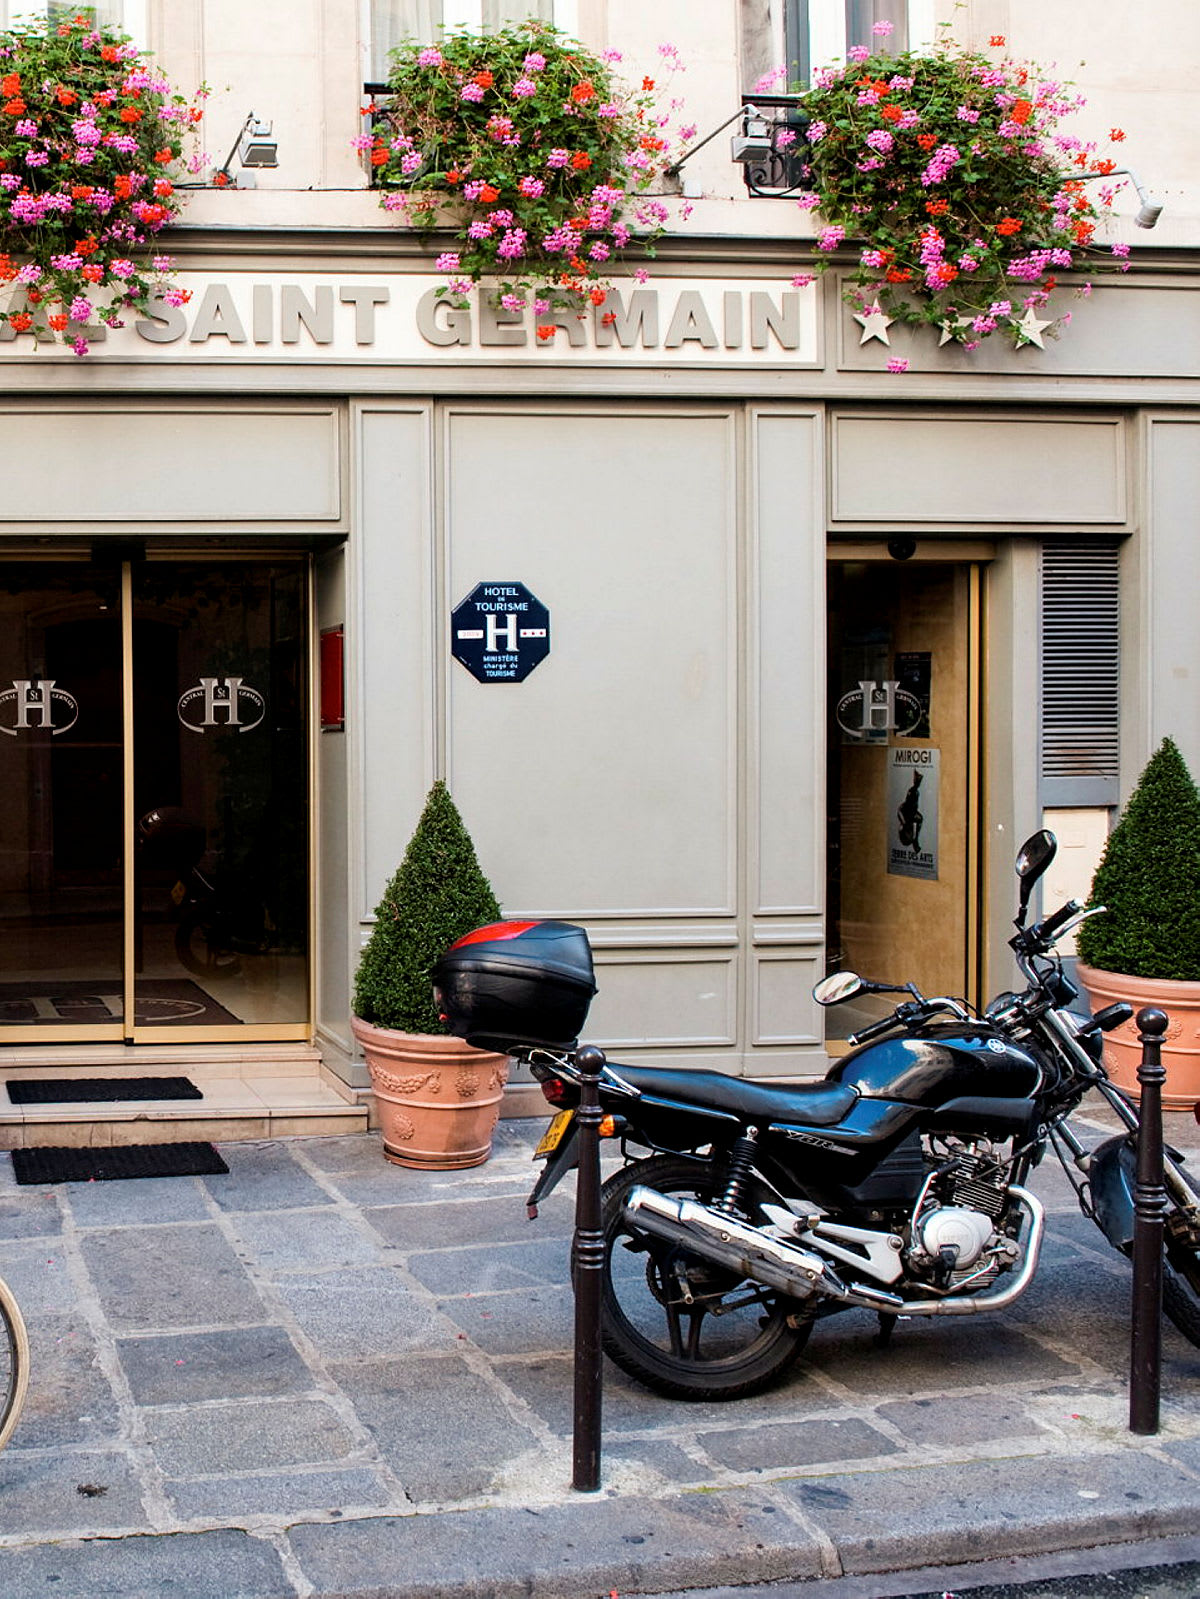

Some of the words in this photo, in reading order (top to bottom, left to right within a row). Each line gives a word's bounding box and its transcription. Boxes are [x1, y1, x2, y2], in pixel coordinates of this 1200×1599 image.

[135, 282, 390, 345] SAINT
[416, 286, 800, 349] GERMAIN
[475, 602, 529, 611] TOURISME
[484, 587, 519, 596] HOTEL
[485, 613, 519, 652] H
[12, 680, 56, 728] H
[199, 677, 243, 725] H
[858, 681, 900, 729] H
[895, 750, 931, 763] MIROGI
